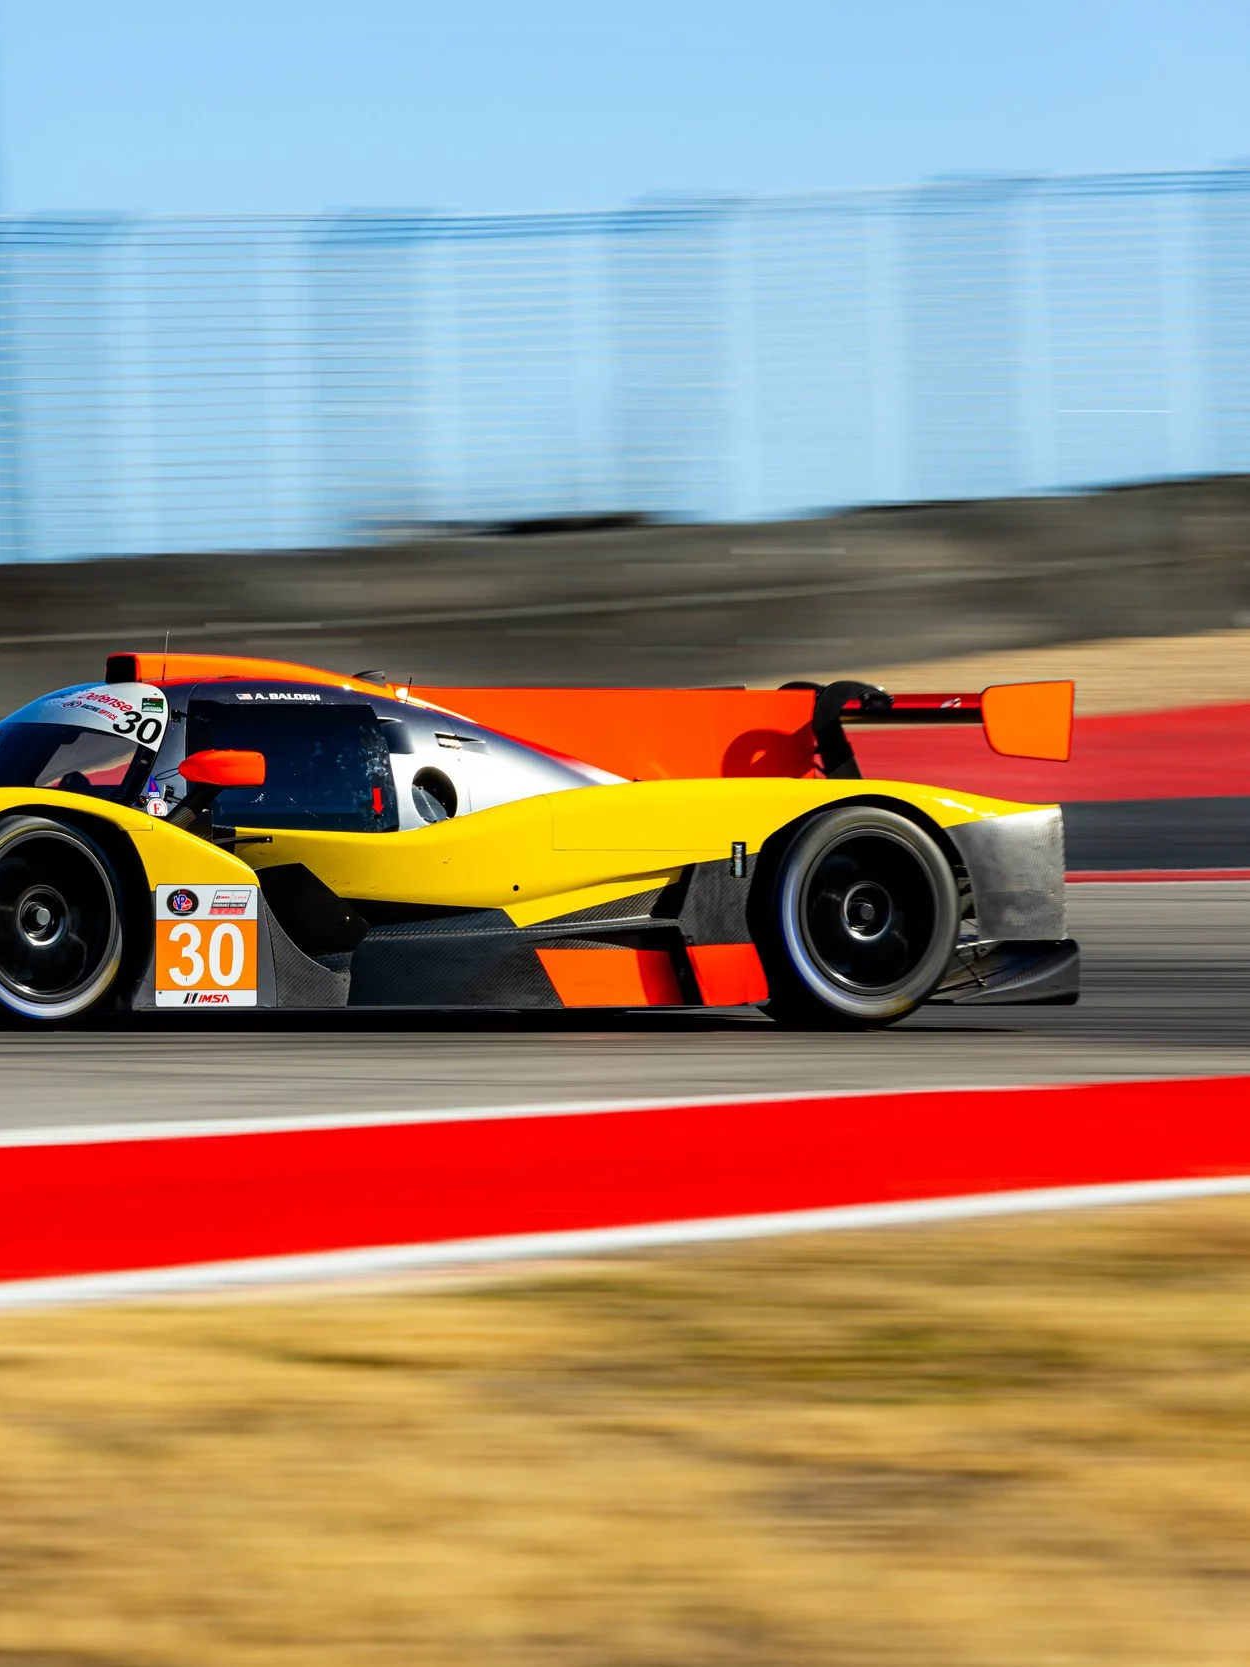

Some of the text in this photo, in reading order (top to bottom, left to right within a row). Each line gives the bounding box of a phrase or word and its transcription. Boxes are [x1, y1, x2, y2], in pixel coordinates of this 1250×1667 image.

[78, 692, 133, 712] Defense
[113, 711, 162, 744] 30
[153, 803, 162, 814] E
[168, 922, 245, 987] 30
[198, 994, 230, 1003] IMSA
